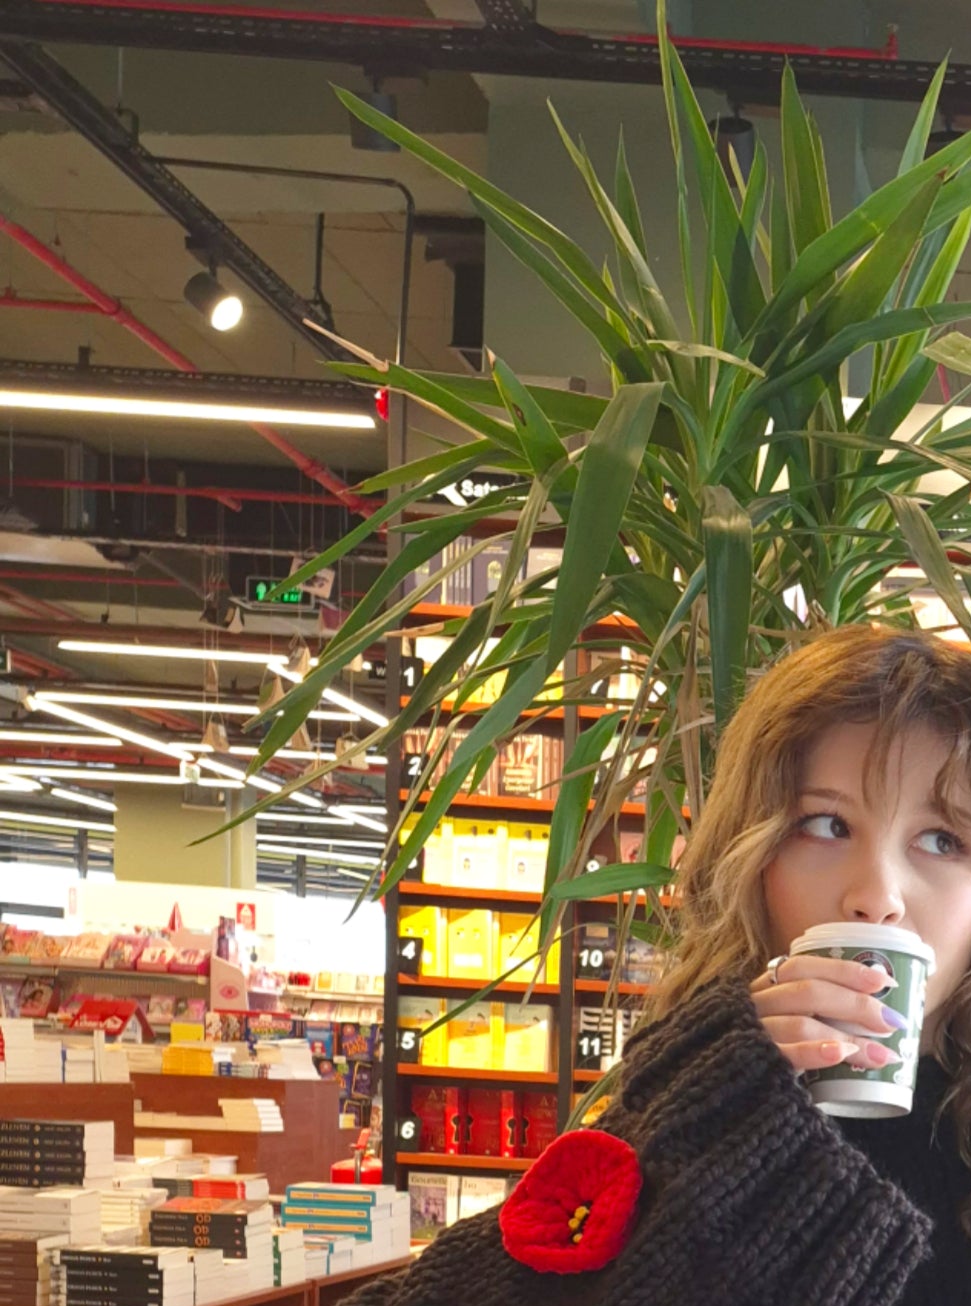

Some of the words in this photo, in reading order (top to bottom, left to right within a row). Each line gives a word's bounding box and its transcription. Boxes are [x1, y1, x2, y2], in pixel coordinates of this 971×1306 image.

[403, 666, 415, 687] 1
[407, 756, 422, 776] 2
[401, 940, 416, 960] 4
[579, 950, 603, 967] 10
[400, 1031, 416, 1050] 5
[579, 1037, 601, 1056] 11
[401, 1120, 415, 1139] 6
